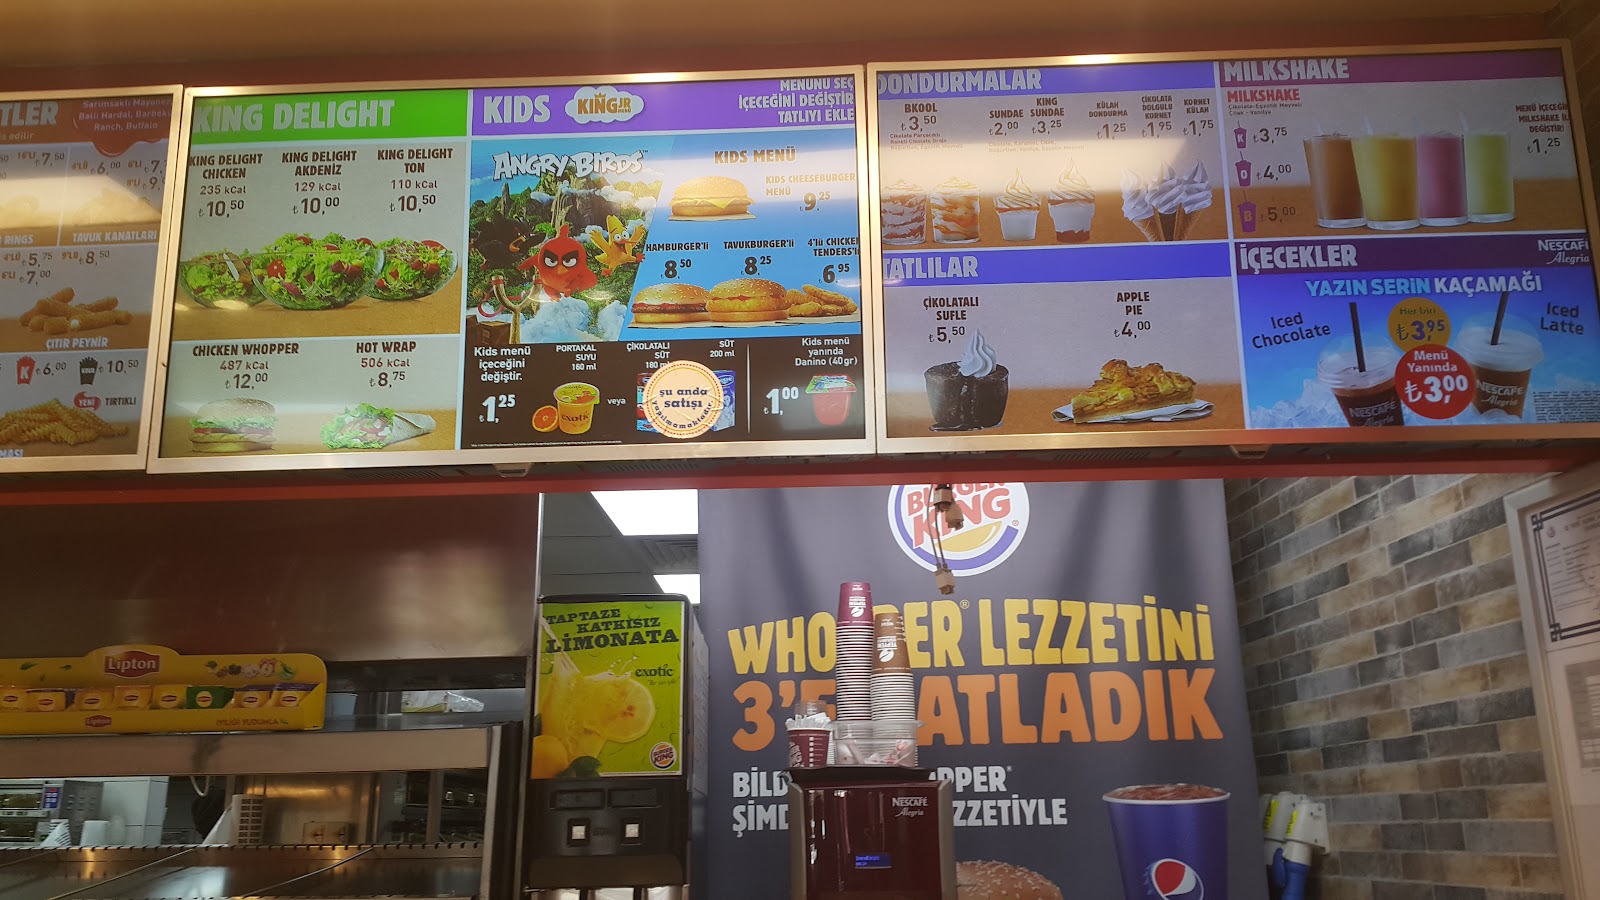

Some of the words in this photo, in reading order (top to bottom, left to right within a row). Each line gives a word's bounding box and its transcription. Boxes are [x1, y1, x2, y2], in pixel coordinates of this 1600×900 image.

[1223, 58, 1350, 82] MILKSHAKE
[780, 78, 831, 92] MENUNU
[877, 68, 1042, 95] DONDURMALAR
[738, 93, 796, 109] İÇECEĞİNİ
[800, 91, 855, 108] DEĞİŞTİR
[1227, 88, 1300, 102] MILKSHAKE
[577, 97, 618, 115] KING
[618, 97, 631, 108] JR
[904, 102, 938, 114] BKOOL
[1036, 97, 1058, 107] KING
[1096, 100, 1119, 110] KÜLAH
[1142, 103, 1173, 111] DOLGULU
[1184, 98, 1211, 106] KORNET
[483, 94, 551, 124] KIDS
[989, 109, 1024, 119] SUNDAE
[1030, 107, 1065, 118] SUNDAE
[1088, 109, 1129, 118] DONDURMA
[1186, 106, 1210, 114] KÜLAH
[192, 103, 263, 133] KING
[272, 99, 396, 129] DELIGHT
[778, 110, 822, 124] TATLIYI
[826, 108, 855, 121] EKLE
[1145, 111, 1172, 120] KORNET
[126, 121, 159, 130] Buffalo
[189, 154, 215, 167] KING
[218, 153, 264, 166] DELIGHT
[282, 151, 308, 163] KING
[311, 150, 357, 162] DELIGHT
[377, 149, 404, 160] KING
[408, 148, 454, 160] DELIGHT
[714, 150, 748, 164] KIDS
[753, 146, 796, 162] MENÜ
[294, 162, 342, 176] AKDENİZ
[404, 162, 426, 174] TON
[492, 150, 570, 181] ANGRY
[202, 167, 247, 180] CHICKEN
[765, 175, 786, 184] KIDS
[788, 172, 856, 183] CHEESEBURGER
[200, 184, 221, 195] 235
[224, 184, 247, 194] kCal
[294, 181, 315, 192] 129
[318, 181, 342, 191] kCal
[390, 179, 412, 190] 110
[415, 179, 438, 189] kCal
[766, 186, 791, 196] MENÜ
[72, 232, 102, 243] TAVUK
[104, 229, 158, 241] KANATLARI
[1239, 244, 1359, 275] İÇECEKLER
[1304, 279, 1369, 297] YAZIN
[1434, 270, 1543, 297] KAÇAMAĞI
[922, 295, 979, 310] ÇİKOLATALI
[1116, 291, 1150, 303] APPLE
[936, 310, 967, 322] SUFLE
[1125, 304, 1143, 316] PIE
[1546, 302, 1580, 318] Iced
[1270, 311, 1304, 329] Iced
[1540, 317, 1585, 335] Latte
[801, 337, 822, 346] Kids
[824, 336, 850, 346] menü
[1251, 323, 1332, 349] Chocolate
[192, 344, 239, 357] CHICKEN
[241, 342, 300, 356] WHOPPER
[356, 342, 380, 354] HOT
[381, 340, 418, 354] WRAP
[555, 344, 597, 353] PORTAKAL
[719, 339, 735, 348] SÜT
[474, 346, 498, 357] Kids
[500, 345, 532, 356] menü
[575, 353, 597, 361] SUYU
[654, 350, 670, 360] SÜT
[709, 349, 724, 358] 200
[724, 349, 735, 358] ml
[808, 346, 844, 357] yanında
[1414, 349, 1449, 361] Menü
[219, 360, 242, 371] 487
[245, 360, 269, 371] kCal
[360, 357, 383, 368] 506
[386, 357, 411, 368] kCal
[478, 357, 526, 370] içeceğini
[571, 363, 585, 371] 160
[586, 362, 597, 371] ml
[645, 361, 659, 369] 180
[794, 357, 827, 366] Danino
[1407, 362, 1458, 372] Yanında
[659, 388, 673, 397] şu
[676, 386, 708, 396] anda
[607, 397, 626, 407] veya
[663, 397, 703, 410] satışı
[547, 608, 621, 625] TAPTAZE
[576, 616, 662, 634] KATKISIZ
[546, 628, 680, 654] LİMONATA
[728, 601, 964, 675] WHOER
[978, 595, 1215, 667] LEZZETİNİ
[107, 656, 157, 673] Lipton
[635, 663, 674, 678] exotic
[917, 667, 1225, 747] ATLADIK
[895, 806, 924, 818] Alegria
